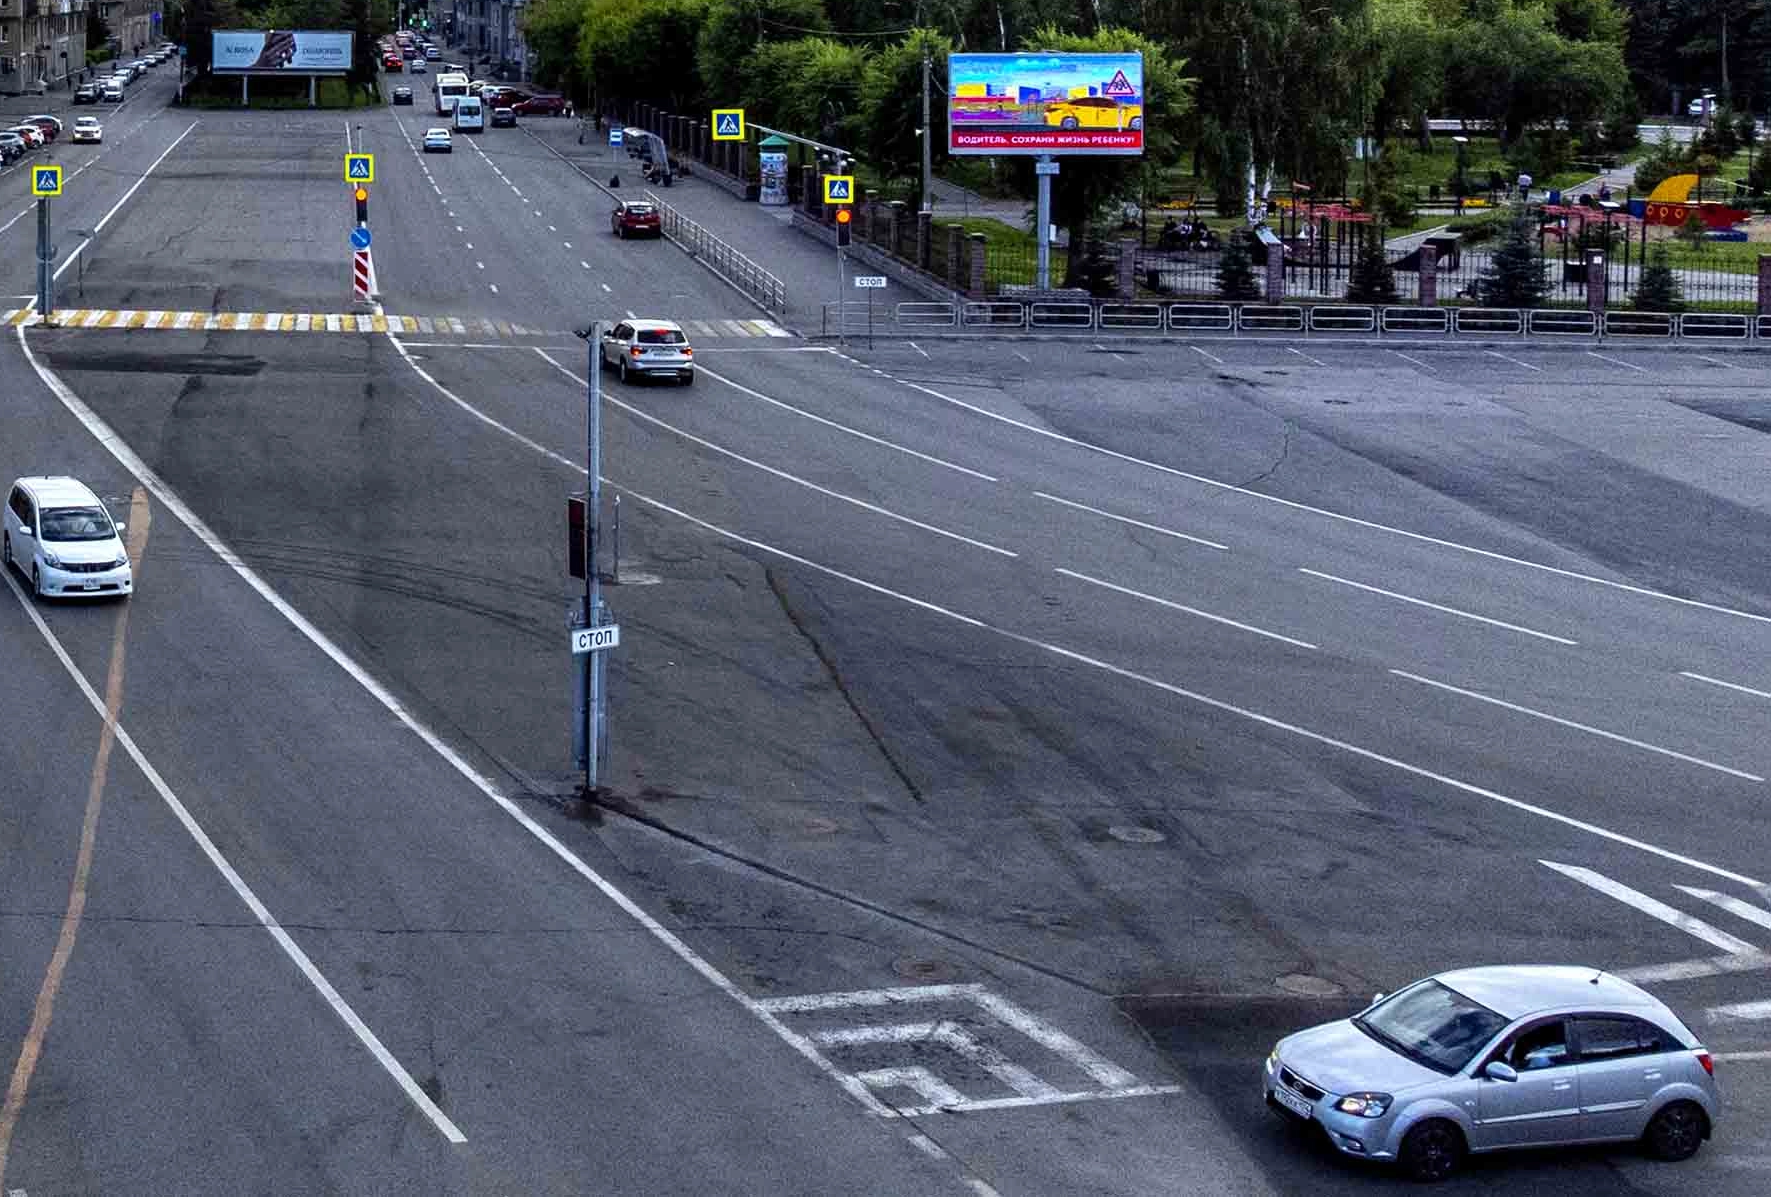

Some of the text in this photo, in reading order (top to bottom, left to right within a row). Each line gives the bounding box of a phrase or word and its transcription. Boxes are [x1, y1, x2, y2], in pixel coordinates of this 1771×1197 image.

[1011, 135, 1055, 144] СОХРАНИ
[1057, 135, 1090, 144] ЖИЗНЬ
[859, 278, 883, 286] СТОП
[579, 630, 613, 649] СТОП
